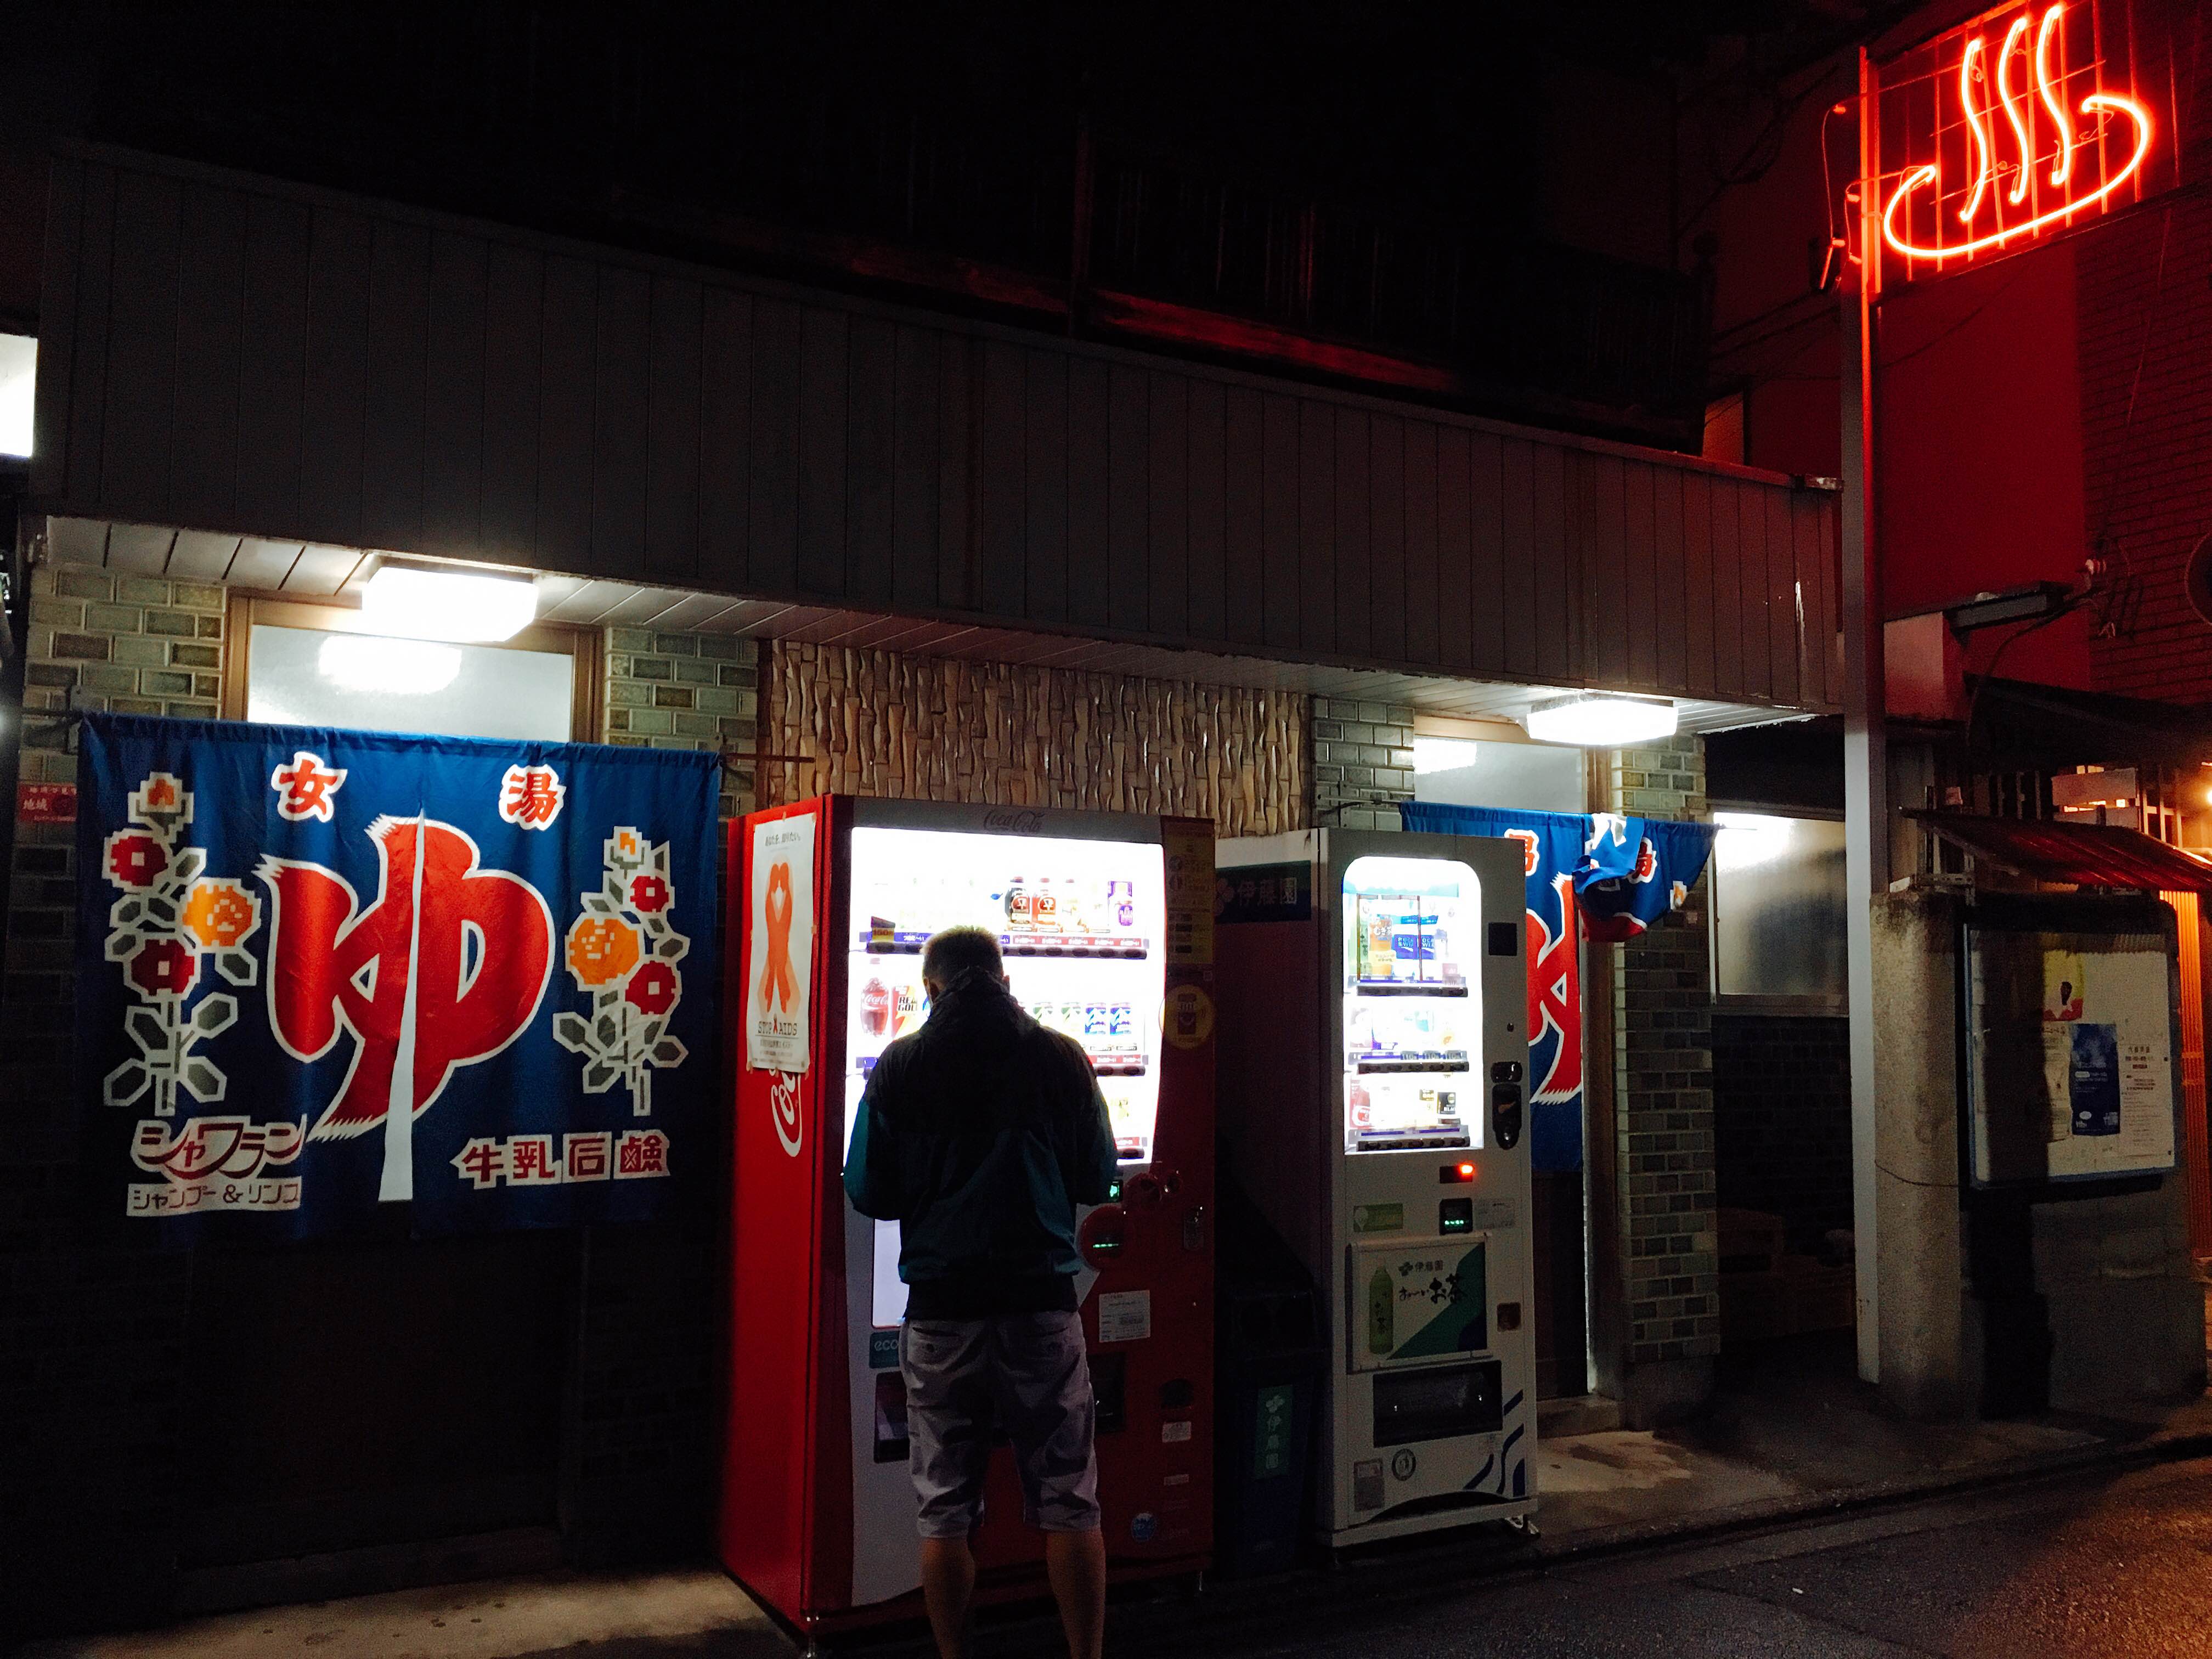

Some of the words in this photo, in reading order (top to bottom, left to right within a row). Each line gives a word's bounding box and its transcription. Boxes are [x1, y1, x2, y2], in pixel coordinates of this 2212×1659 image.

[276, 756, 342, 819] 女
[503, 769, 561, 826] 湯
[258, 814, 553, 1141] ゆ
[778, 1022, 798, 1036] AIDS
[137, 1122, 302, 1180] シャワラン
[222, 1184, 243, 1204] &
[874, 1339, 898, 1352] eco
